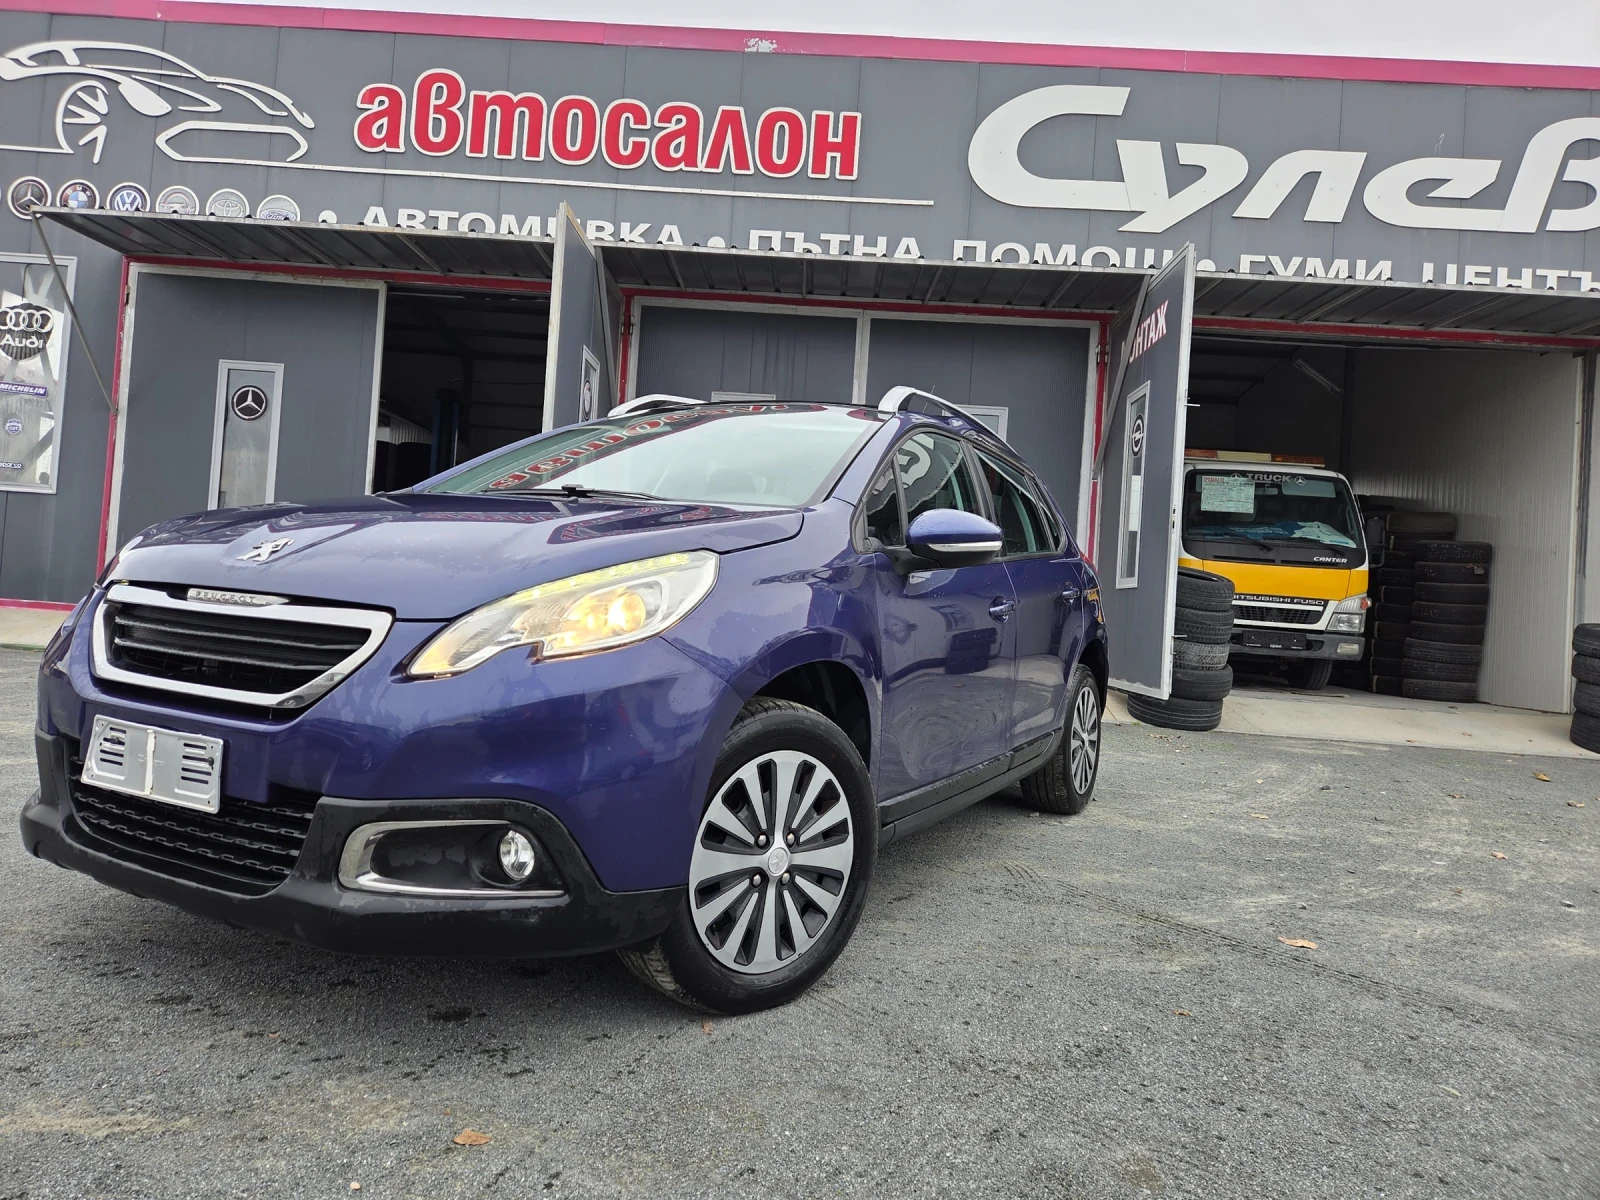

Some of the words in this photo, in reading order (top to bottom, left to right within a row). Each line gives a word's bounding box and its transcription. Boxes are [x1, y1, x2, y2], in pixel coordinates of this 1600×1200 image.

[353, 68, 862, 181] автосалон
[968, 84, 1600, 233] Сулев
[1121, 299, 1169, 364] НТАЖ
[0, 334, 43, 349] Audi
[0, 383, 46, 394] MICHELIN
[1246, 473, 1291, 483] TRUCK
[195, 590, 256, 604] PEUGEOT
